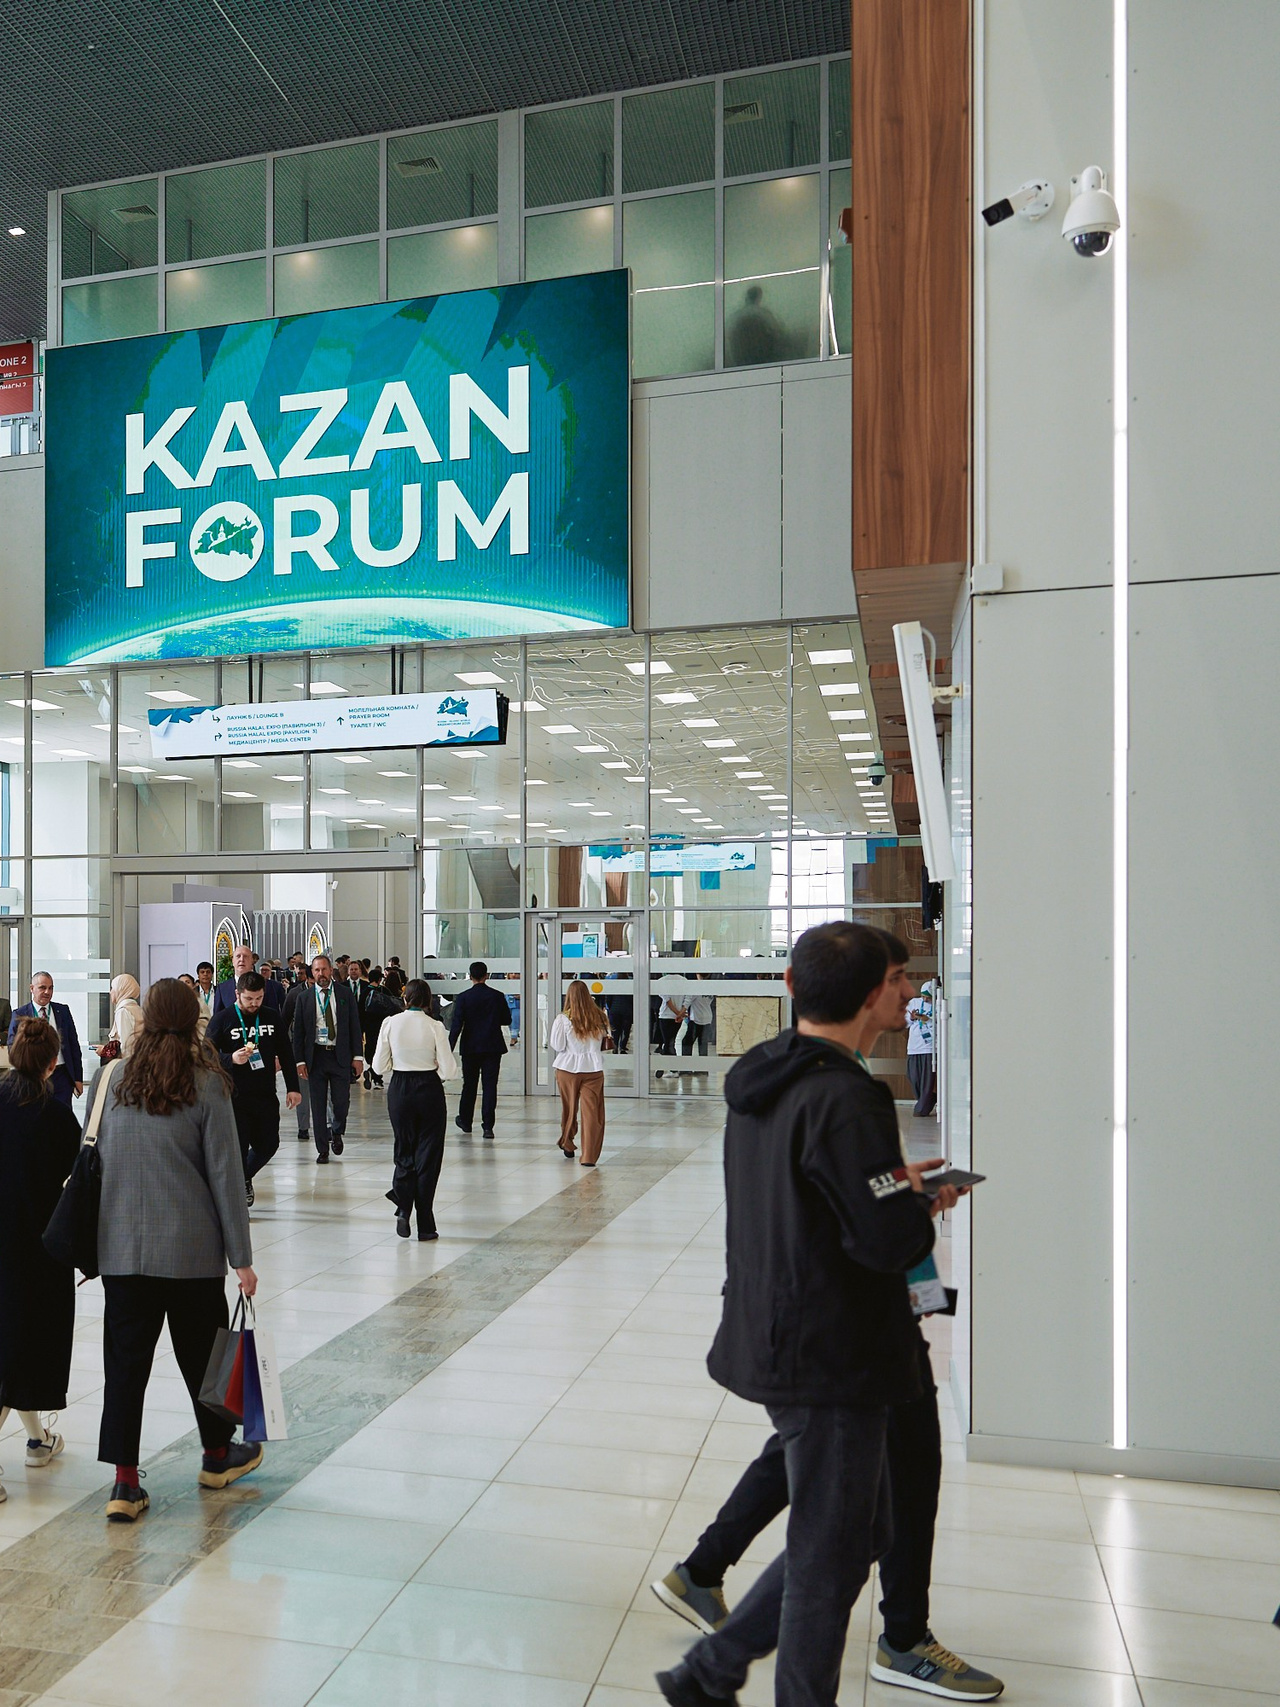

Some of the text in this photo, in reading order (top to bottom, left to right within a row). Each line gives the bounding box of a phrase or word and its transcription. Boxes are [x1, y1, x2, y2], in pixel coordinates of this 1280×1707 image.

[21, 356, 27, 364] 2
[125, 364, 530, 496] KAZAN
[125, 471, 530, 588] FORUM
[230, 1024, 274, 1040] STAFF
